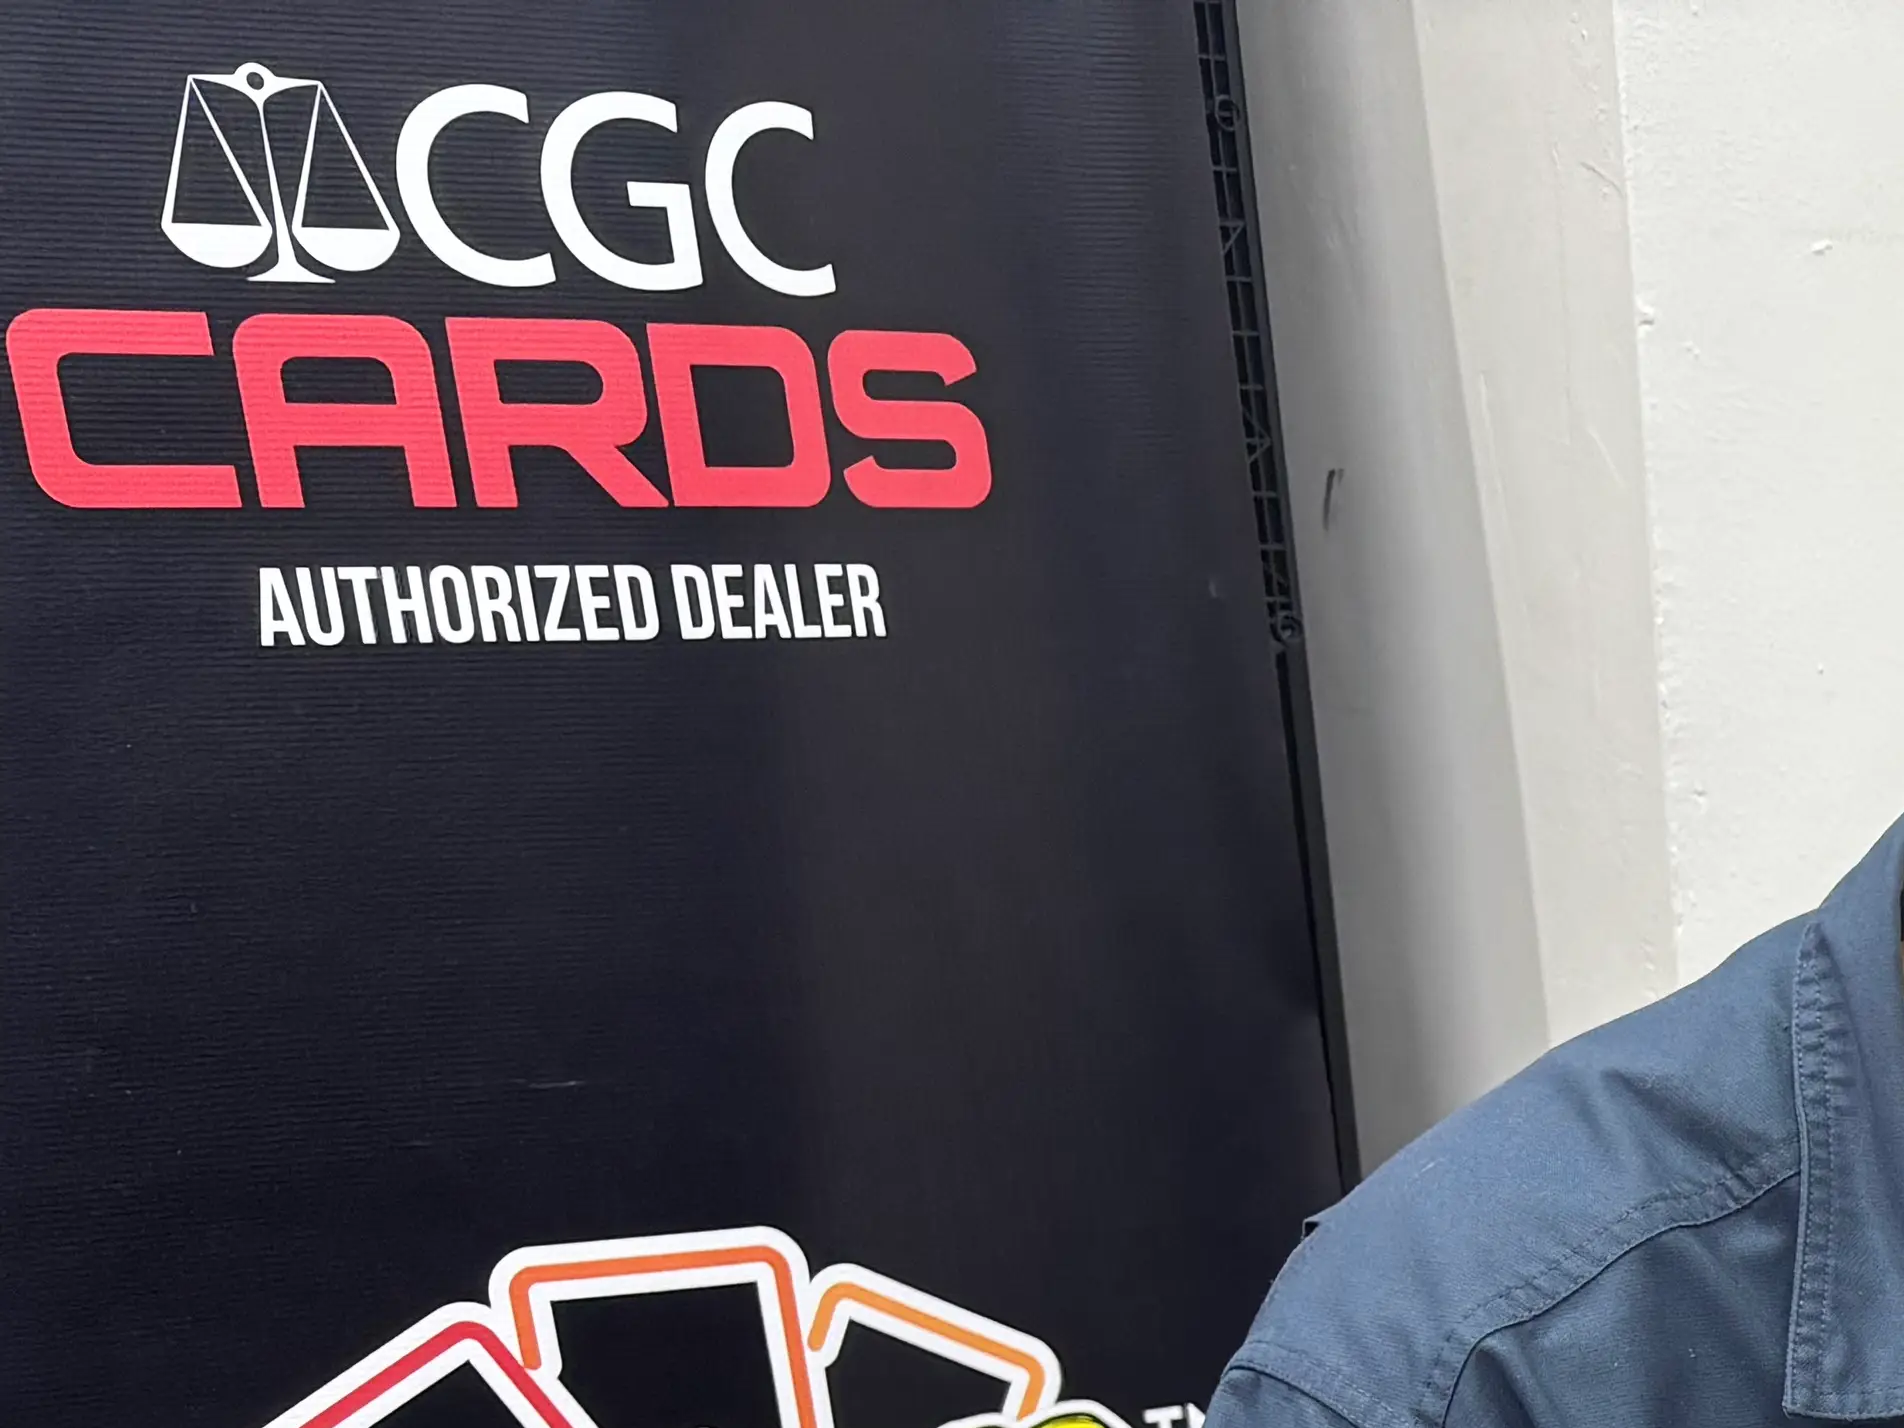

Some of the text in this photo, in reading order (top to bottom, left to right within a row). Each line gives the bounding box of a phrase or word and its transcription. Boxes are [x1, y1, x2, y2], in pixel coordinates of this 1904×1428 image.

[396, 83, 836, 297] CGC
[5, 307, 993, 509] CARDS
[257, 562, 888, 646] AUTHORIZED DEALER
